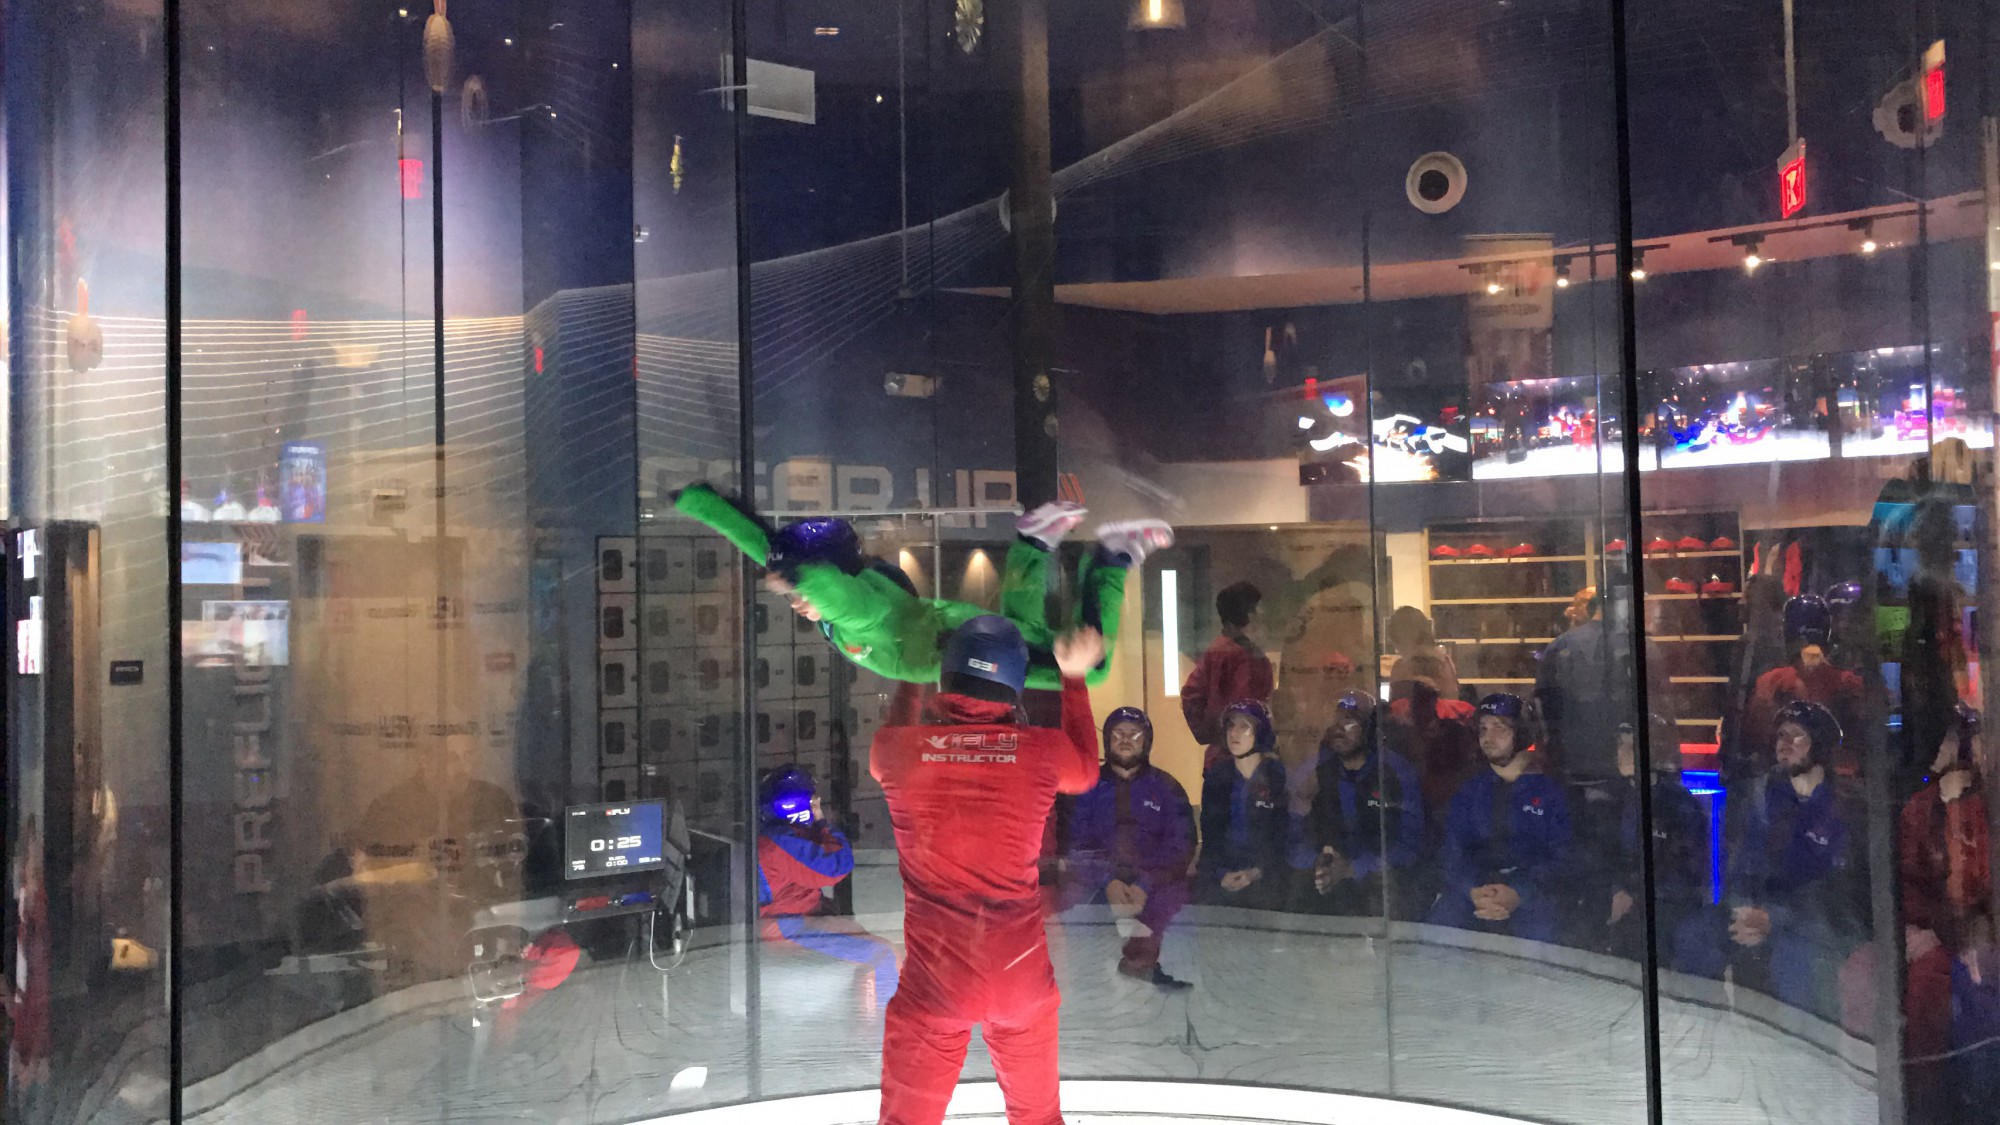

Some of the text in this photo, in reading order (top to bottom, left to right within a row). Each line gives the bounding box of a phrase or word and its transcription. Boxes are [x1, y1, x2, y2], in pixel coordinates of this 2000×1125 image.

[921, 753, 1017, 764] INSTRUCTOR
[786, 809, 811, 824] 73
[590, 835, 642, 852] 0:25
